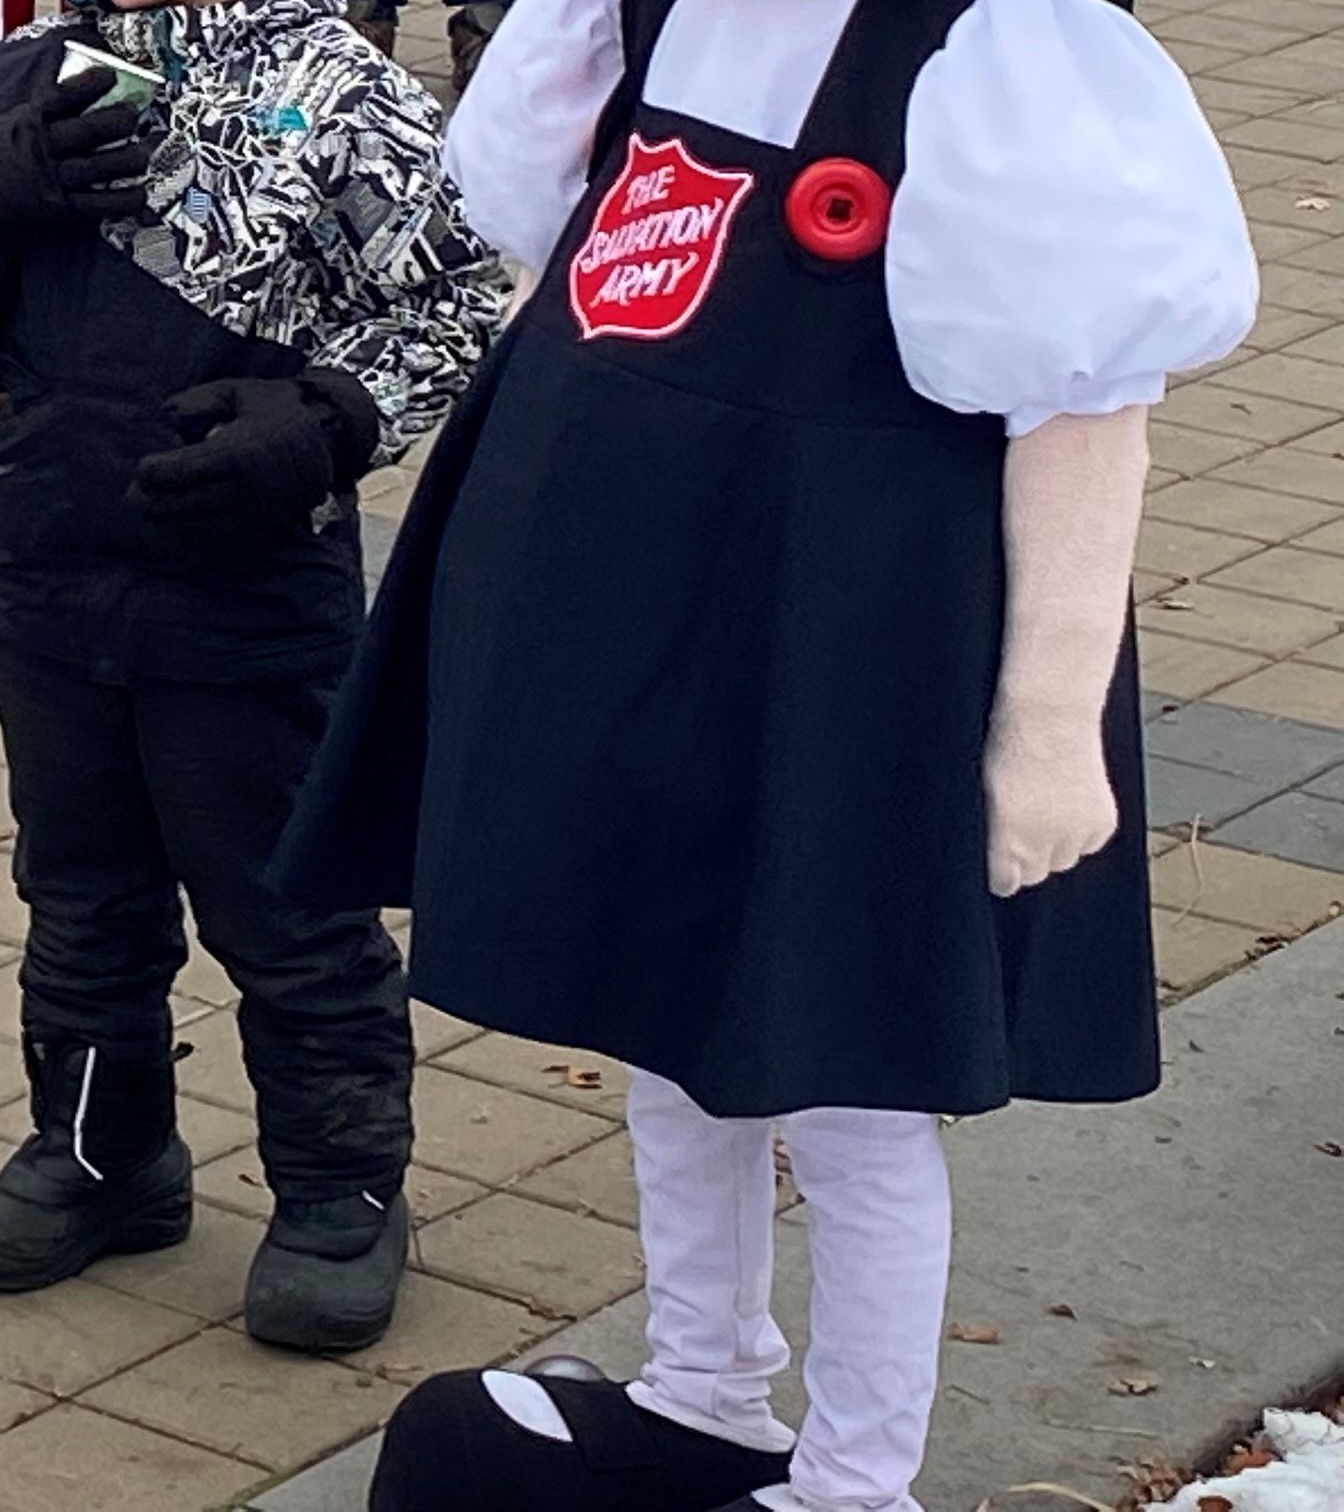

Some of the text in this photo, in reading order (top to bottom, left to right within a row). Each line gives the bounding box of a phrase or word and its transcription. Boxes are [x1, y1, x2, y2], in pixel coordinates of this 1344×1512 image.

[622, 164, 676, 215] THE
[580, 197, 724, 274] SALVATION
[588, 252, 700, 309] ARMY
